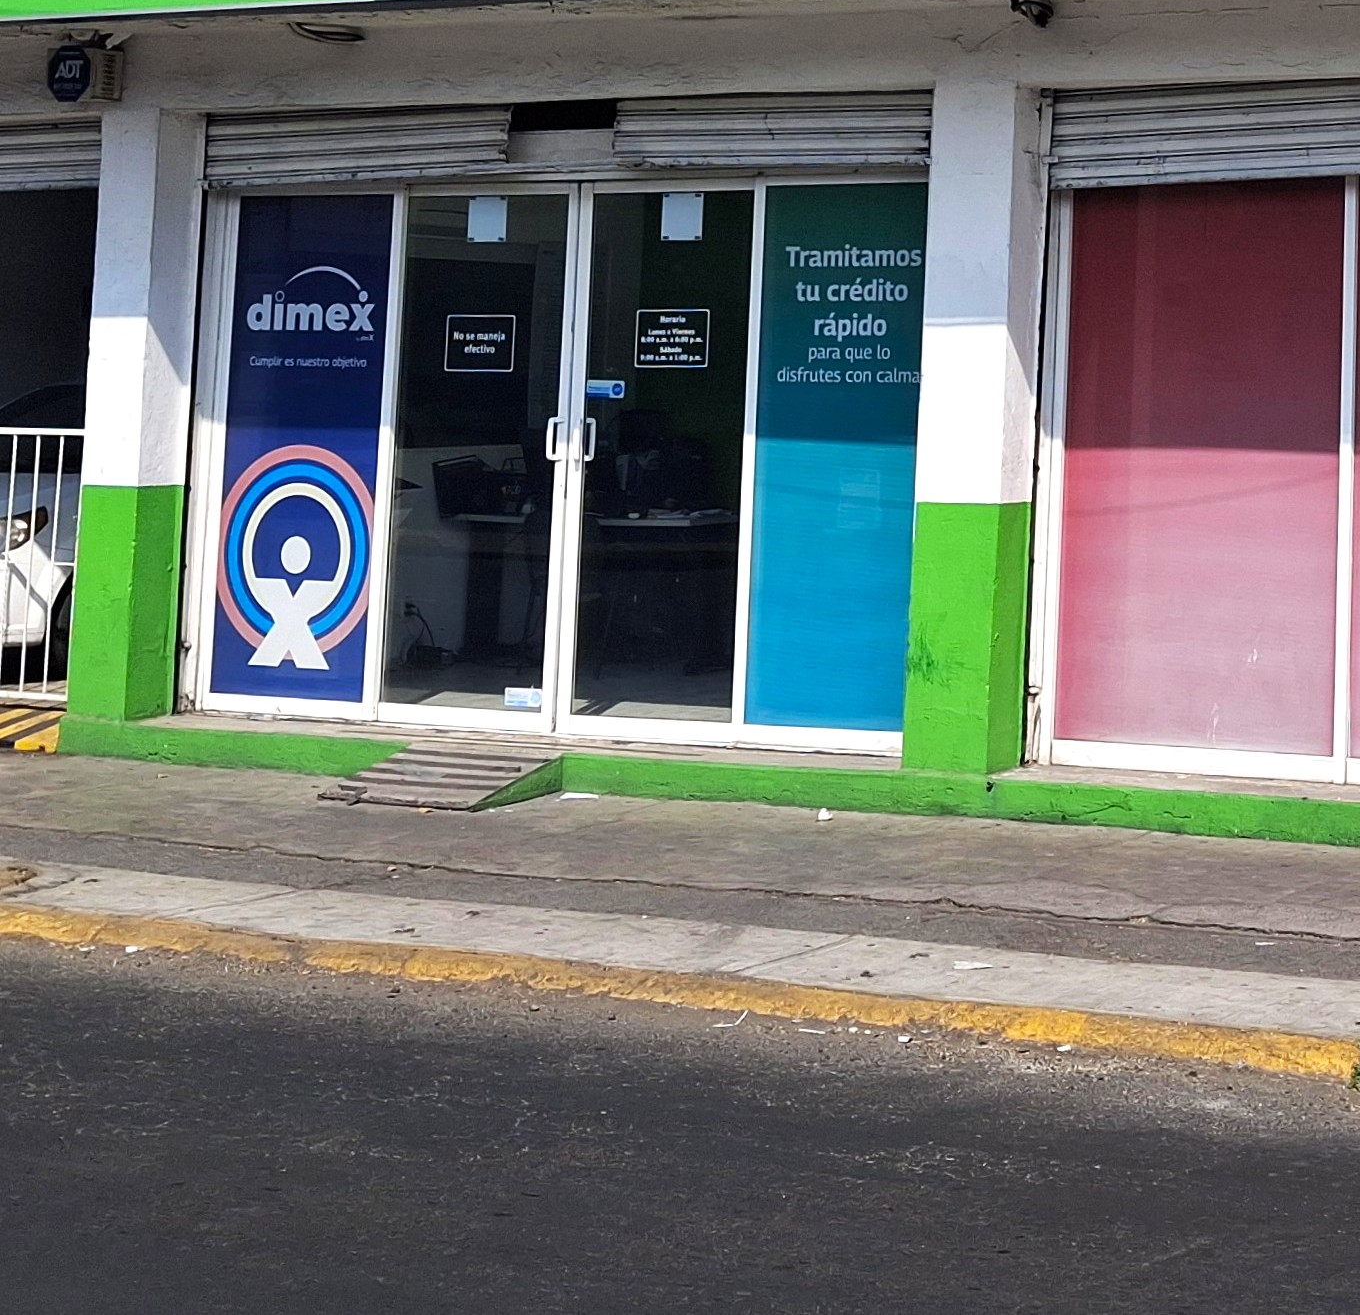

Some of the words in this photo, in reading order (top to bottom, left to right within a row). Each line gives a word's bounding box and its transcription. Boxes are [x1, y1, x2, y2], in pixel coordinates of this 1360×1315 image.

[54, 59, 84, 79] ADT
[785, 244, 922, 268] Tramitamos
[795, 281, 821, 302] tu
[826, 277, 909, 302] crédito
[246, 290, 376, 332] dimex
[453, 331, 464, 341] No
[466, 333, 476, 341] se
[476, 330, 506, 343] maneja
[813, 312, 888, 343] rápido
[464, 343, 496, 354] efectivo
[808, 346, 841, 363] para
[845, 346, 872, 363] que
[876, 344, 891, 360] lo
[249, 355, 282, 369] Cumplir
[284, 358, 295, 367] es
[296, 356, 330, 367] nuestro
[331, 356, 368, 370] objetivo
[776, 366, 841, 383] disfrutes
[845, 370, 872, 383] con
[876, 367, 921, 383] calma
